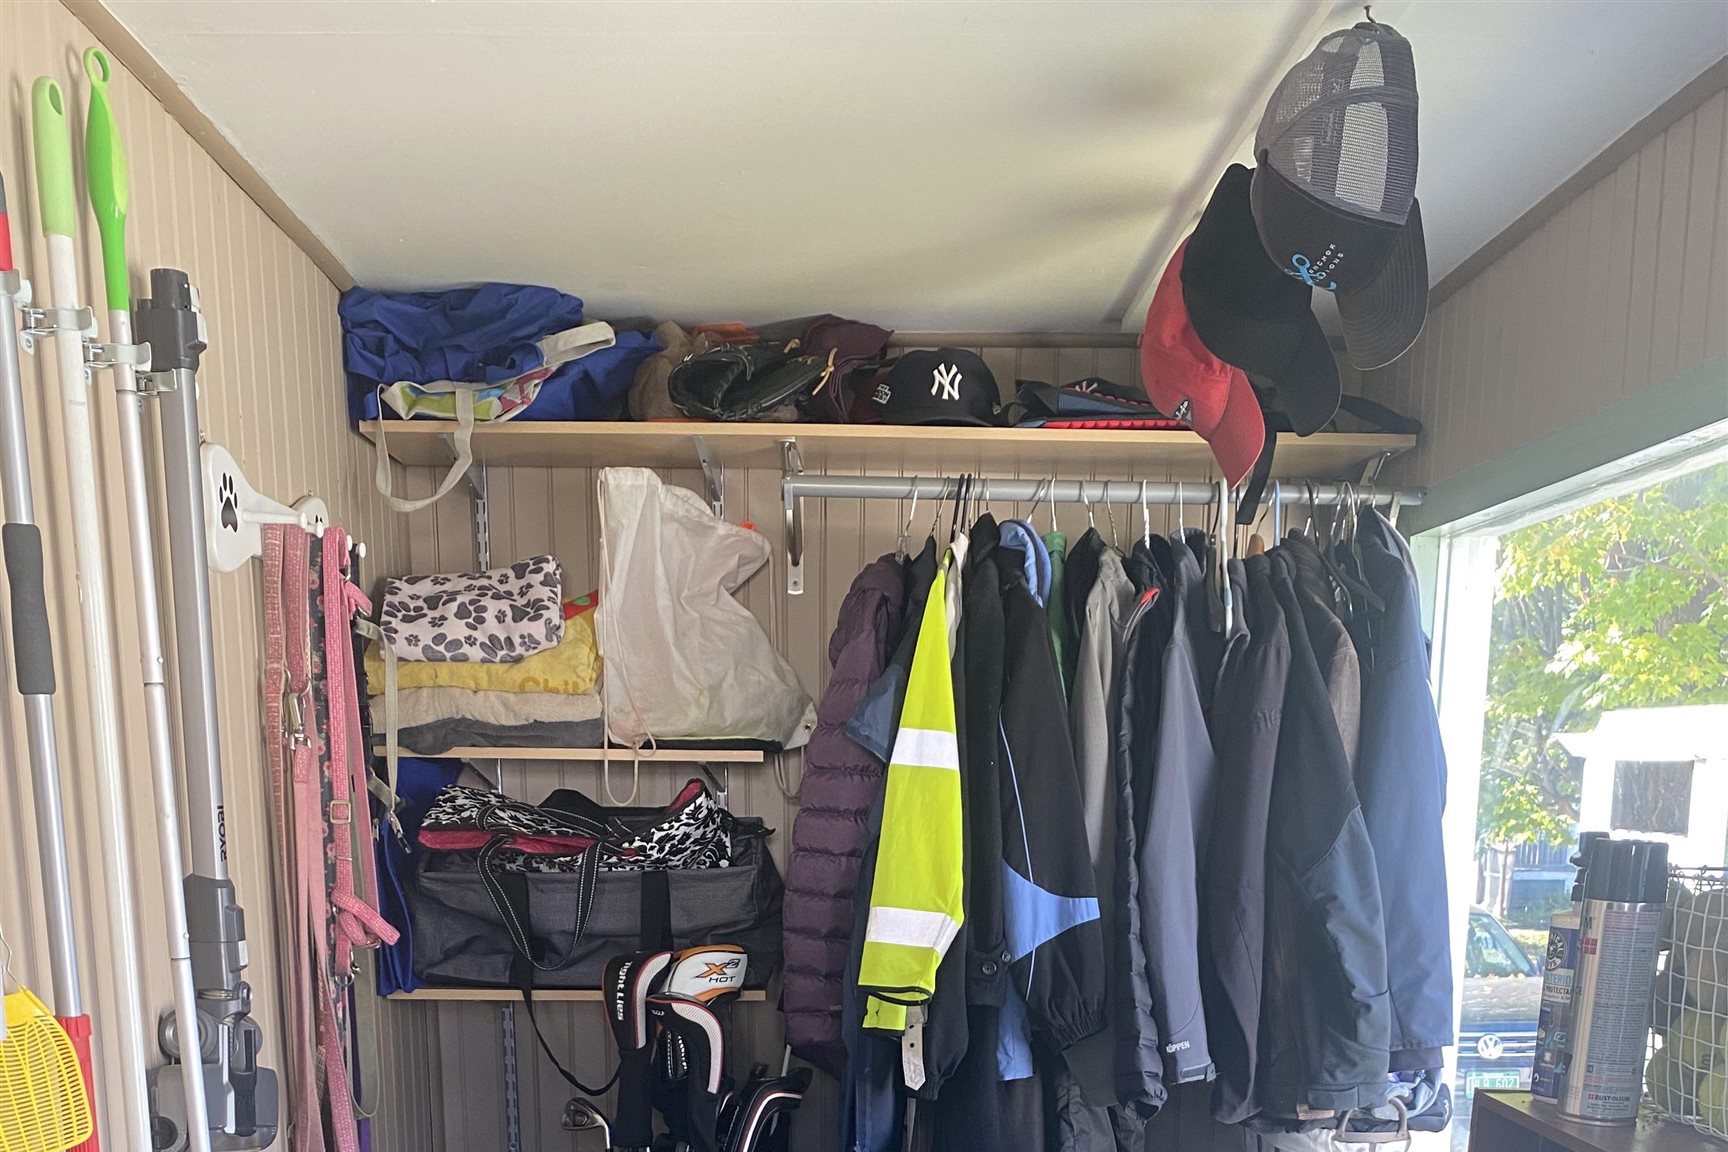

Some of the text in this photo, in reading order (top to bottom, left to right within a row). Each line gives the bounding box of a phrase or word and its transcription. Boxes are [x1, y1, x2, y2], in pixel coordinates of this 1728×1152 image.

[217, 805, 227, 862] RYOBI
[616, 960, 633, 1021] Tight Lies
[708, 975, 737, 984] HOT
